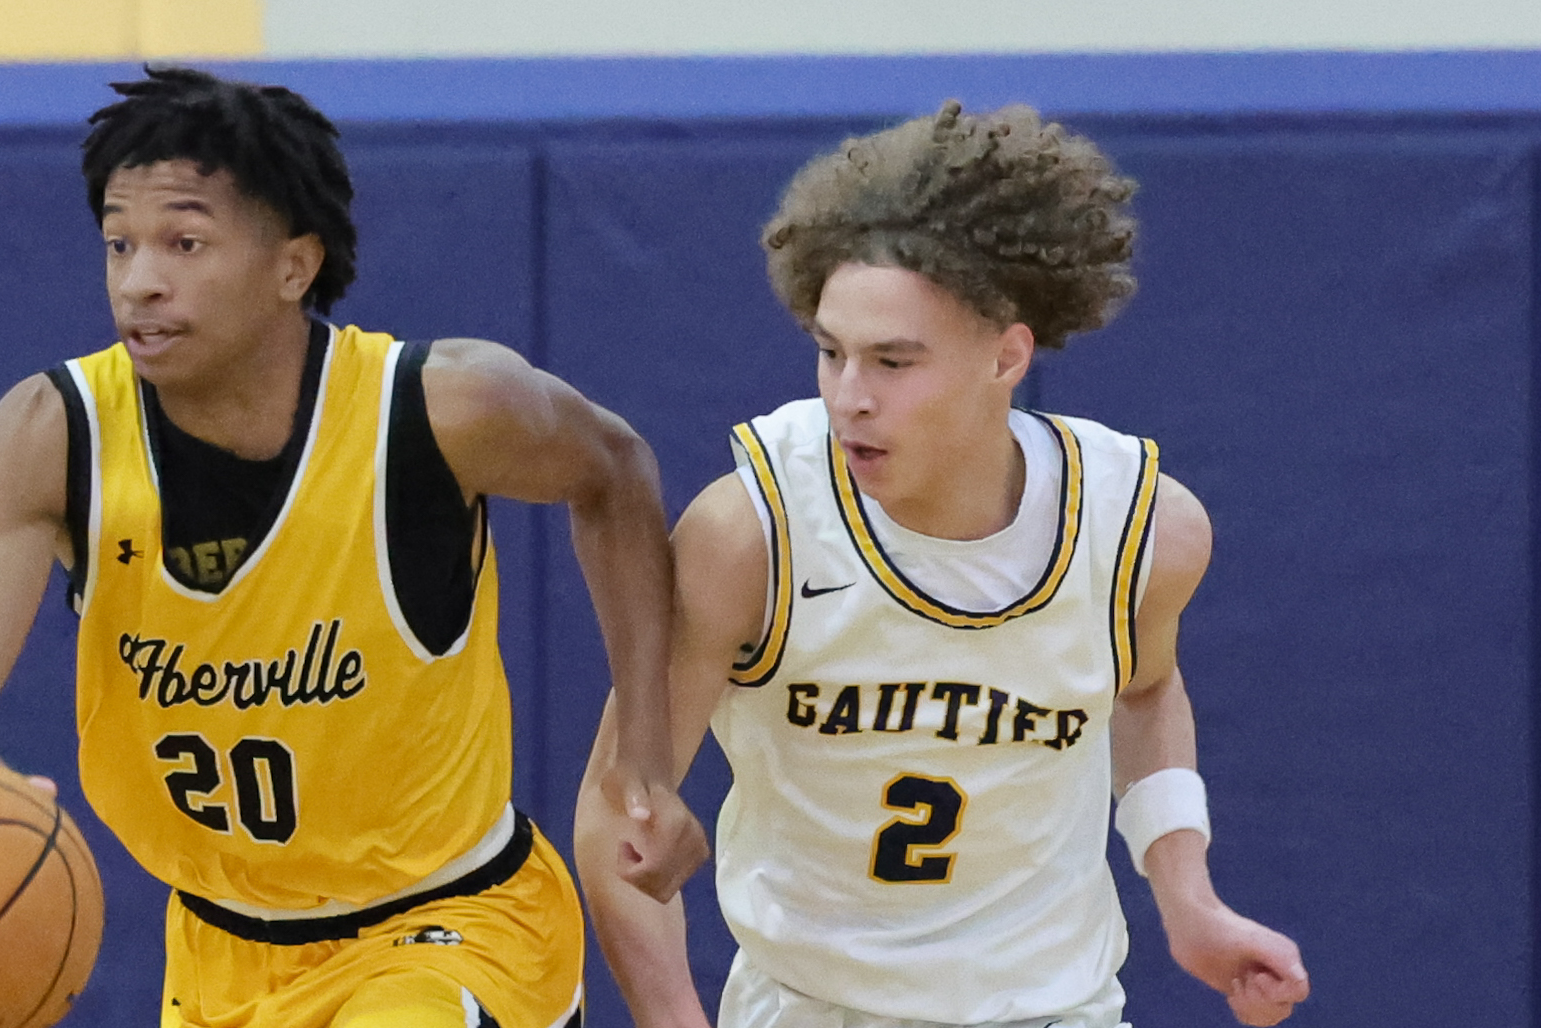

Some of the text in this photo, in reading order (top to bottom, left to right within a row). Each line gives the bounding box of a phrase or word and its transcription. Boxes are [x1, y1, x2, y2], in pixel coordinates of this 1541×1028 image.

[786, 681, 1089, 751] GAUTIER
[153, 731, 298, 846] 20
[869, 771, 968, 885] 2
